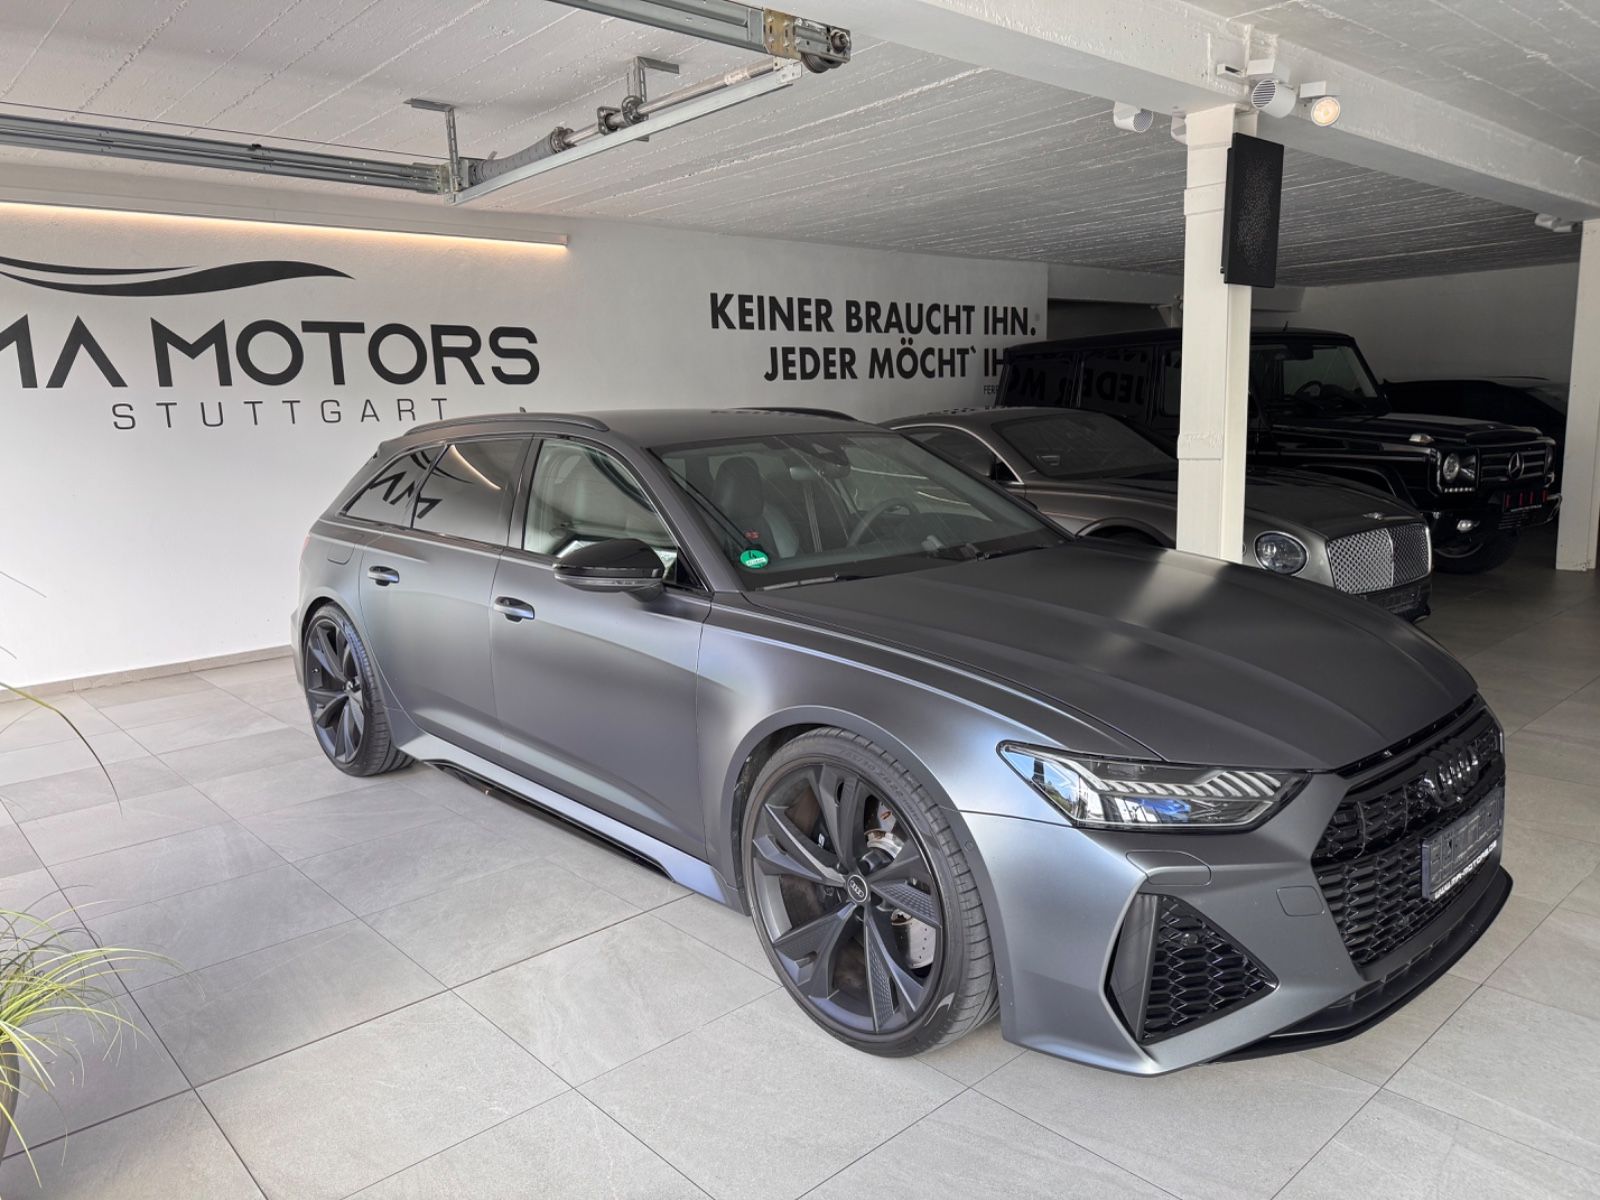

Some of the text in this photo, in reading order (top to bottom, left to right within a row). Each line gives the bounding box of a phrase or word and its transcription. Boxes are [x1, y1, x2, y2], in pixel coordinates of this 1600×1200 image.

[710, 292, 1036, 336] KEINER BRAUCHT IHN.
[150, 316, 540, 387] MOTORS
[764, 346, 857, 381] JEDER
[112, 398, 448, 430] STUTTGART
